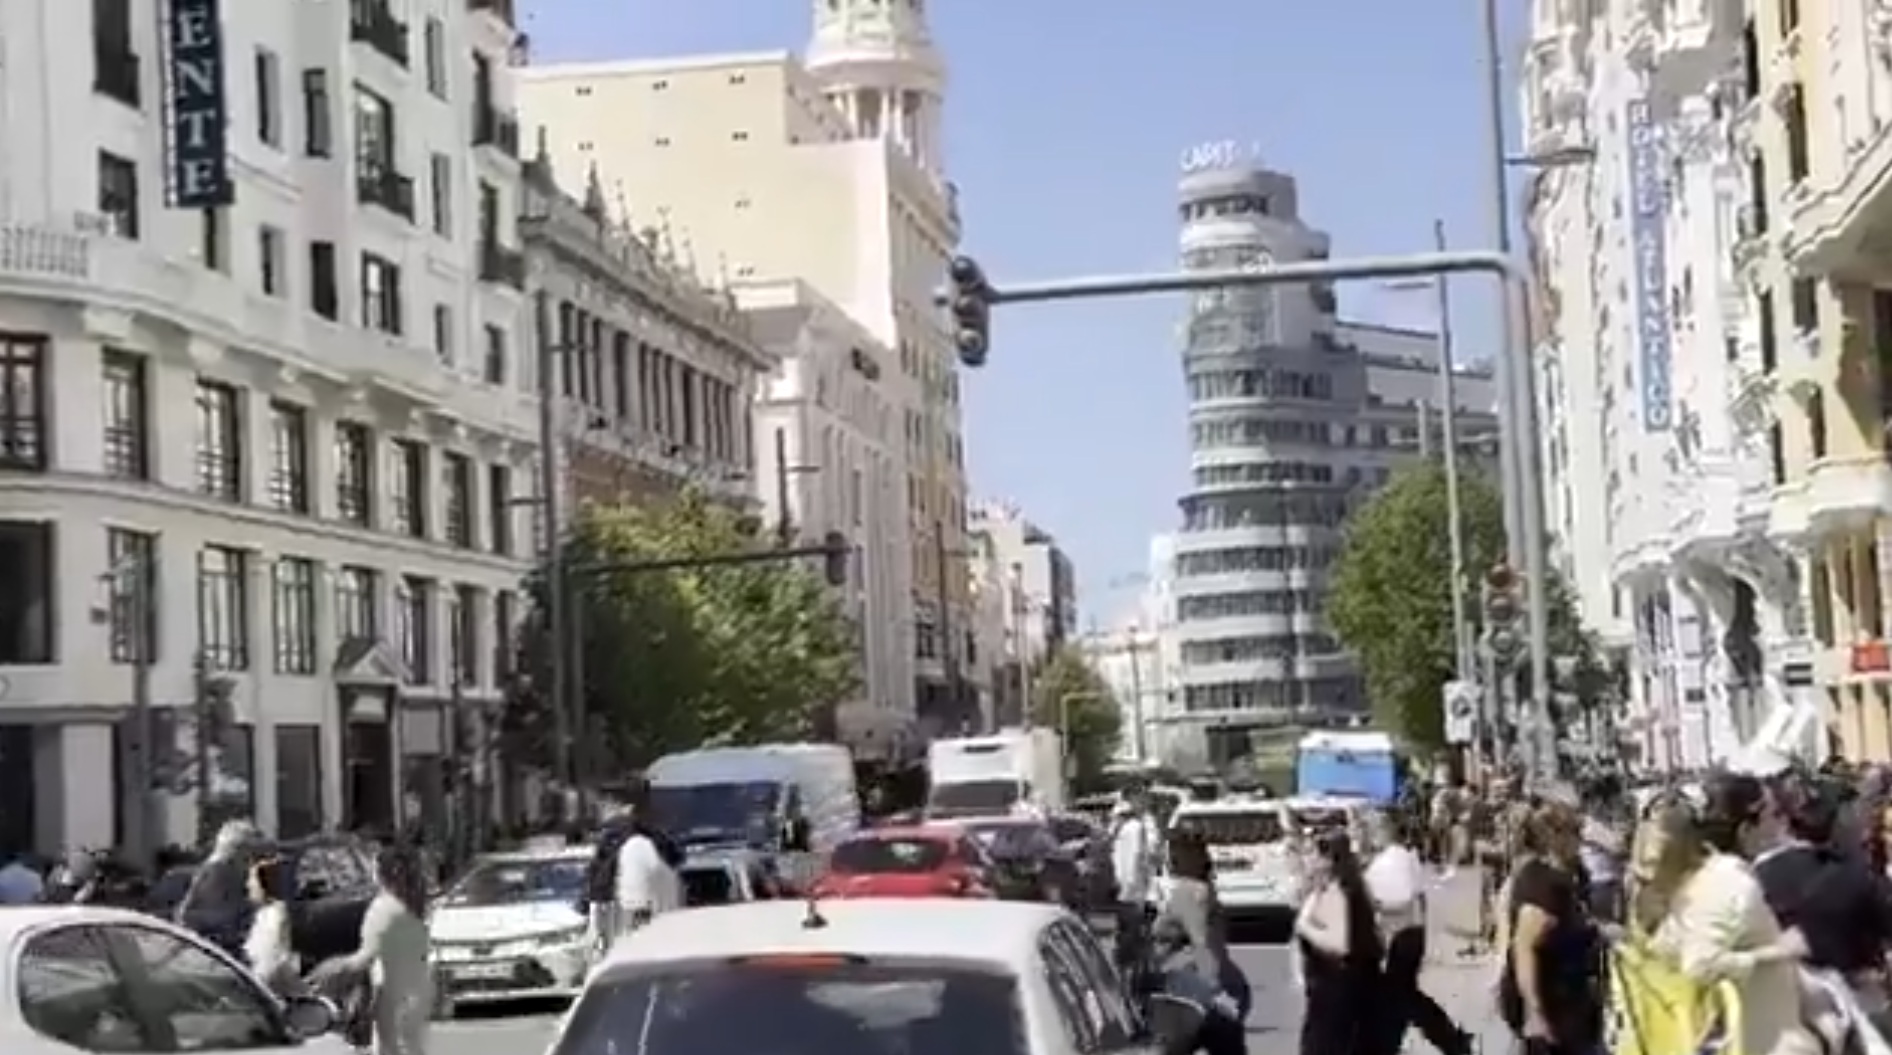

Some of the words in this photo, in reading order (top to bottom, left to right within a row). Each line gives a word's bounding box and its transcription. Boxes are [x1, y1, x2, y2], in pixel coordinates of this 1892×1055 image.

[176, 3, 217, 197] ENTE
[1180, 139, 1261, 171] CAPIT
[1632, 103, 1657, 215] HOTEL
